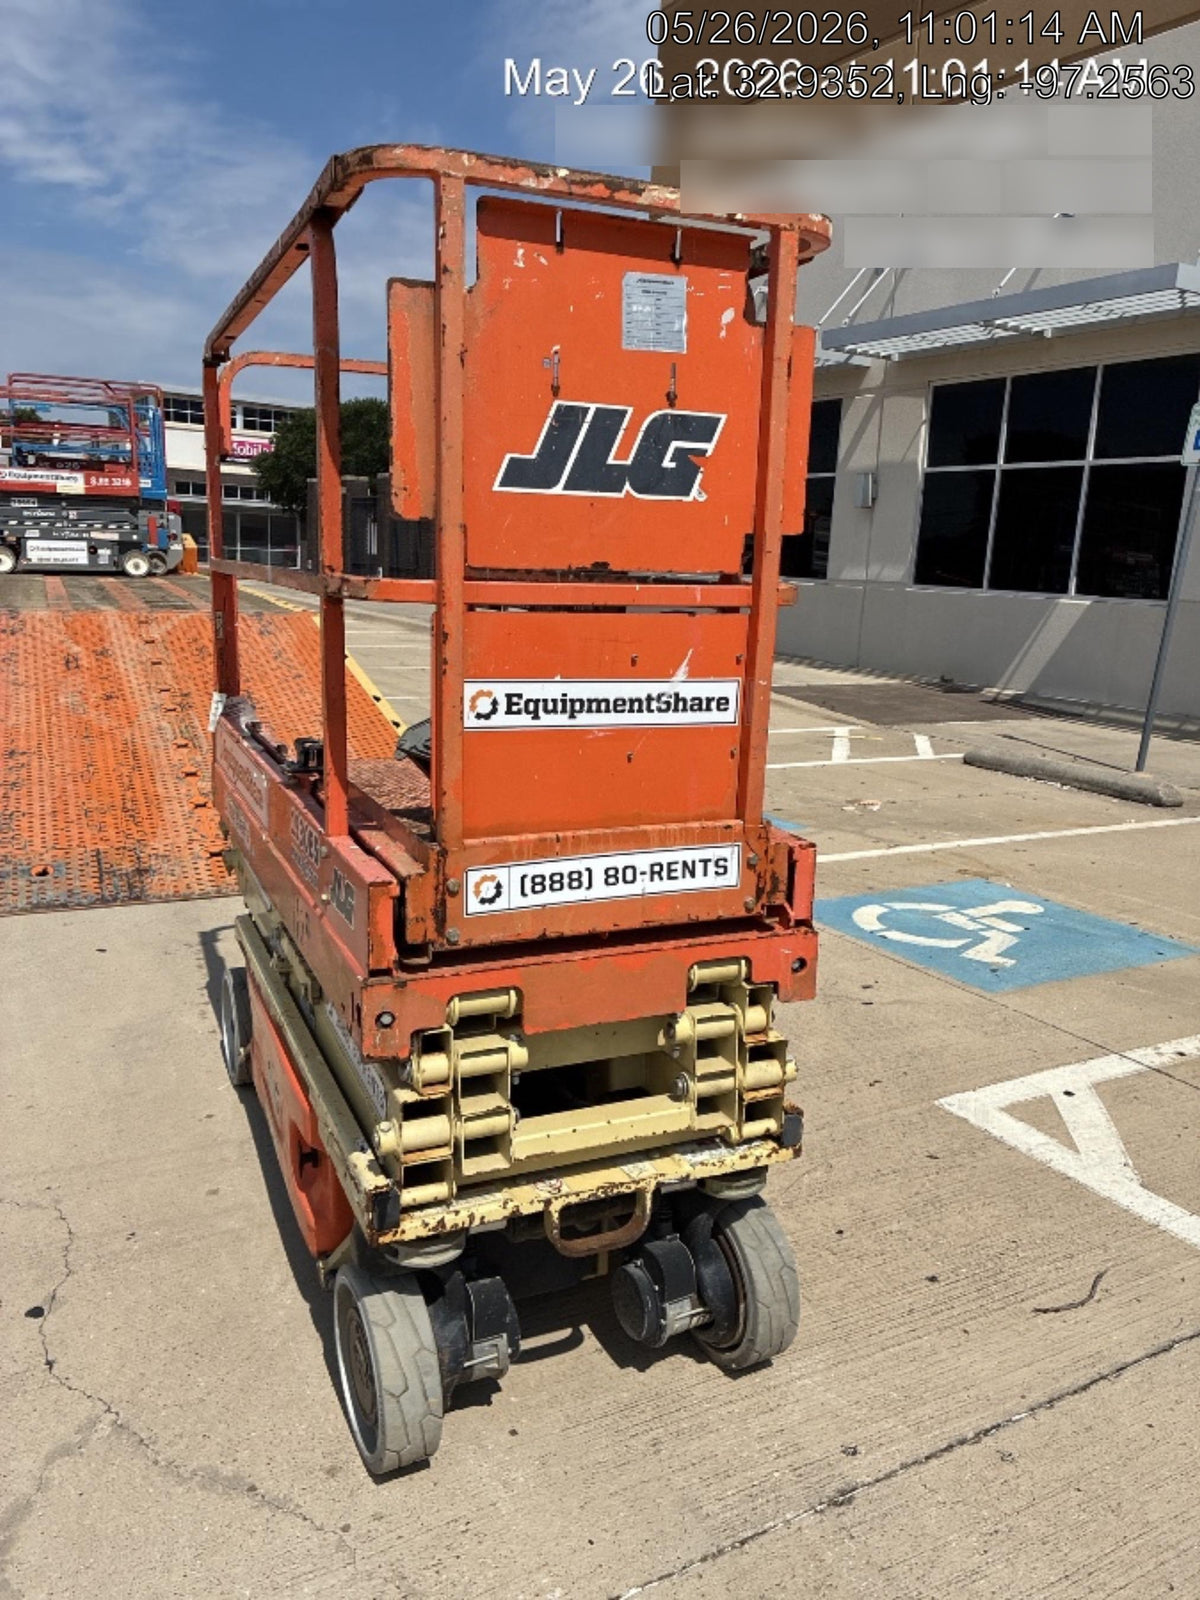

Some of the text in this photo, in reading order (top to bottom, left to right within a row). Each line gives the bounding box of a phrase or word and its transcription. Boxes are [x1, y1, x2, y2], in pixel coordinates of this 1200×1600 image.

[492, 399, 728, 502] JLG
[504, 692, 730, 721] EquipmentShare
[520, 857, 730, 898] (888) 80-RENTS
